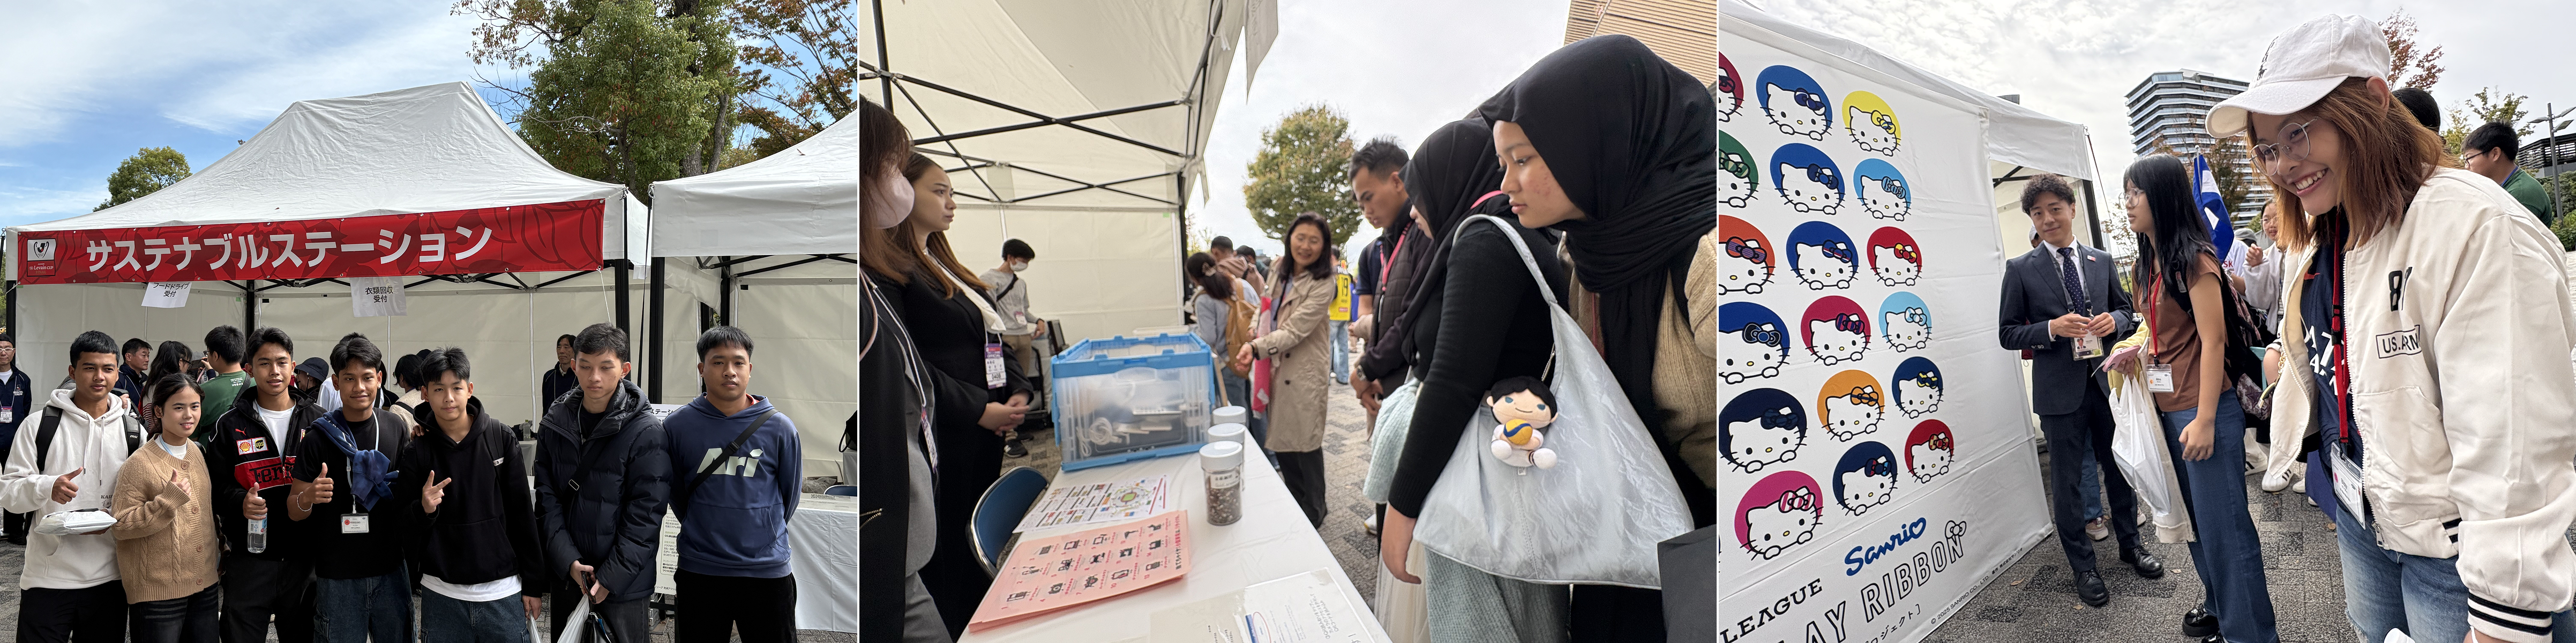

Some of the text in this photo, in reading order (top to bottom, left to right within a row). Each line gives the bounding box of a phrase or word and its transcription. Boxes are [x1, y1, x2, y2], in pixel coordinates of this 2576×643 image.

[86, 226, 492, 273] サステナブルステーション
[153, 282, 190, 290] フードドライブ
[365, 286, 393, 295] 衣類回収
[373, 295, 387, 303] 受付
[1341, 276, 1348, 296] 19
[697, 448, 763, 477] Ari
[1845, 517, 1926, 576] Sanrio
[1861, 535, 1964, 623] RIBBON
[1937, 608, 1950, 619] 2025
[1950, 592, 1970, 609] SANRIO
[1999, 548, 2023, 569] 株式会社サンリオ
[1720, 578, 1822, 643] LEAGUE
